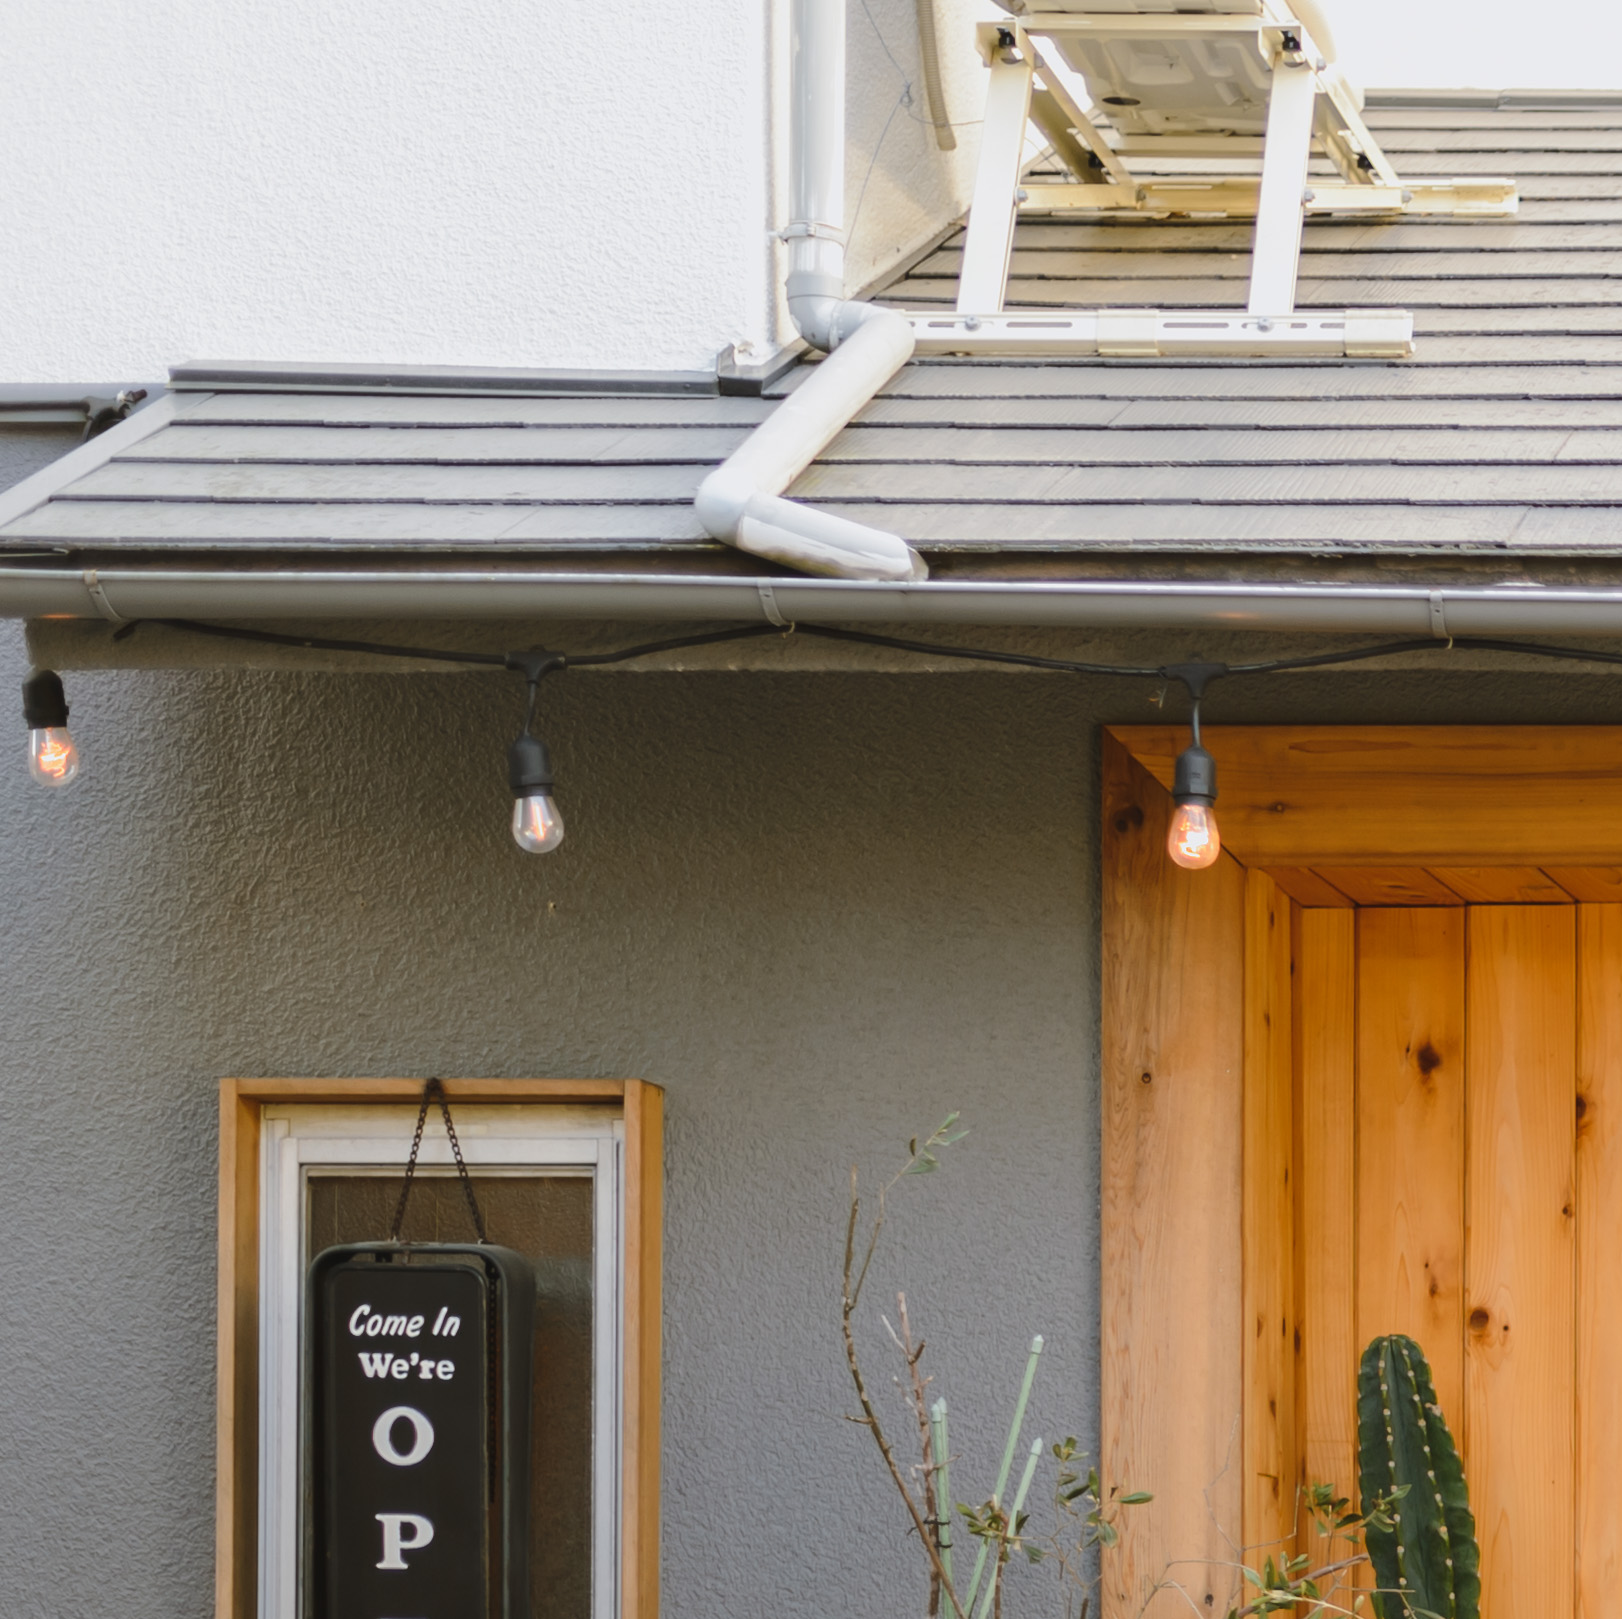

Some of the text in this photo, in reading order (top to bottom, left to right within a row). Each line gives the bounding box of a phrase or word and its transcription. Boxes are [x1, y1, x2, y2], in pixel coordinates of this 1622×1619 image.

[349, 1304, 460, 1338] Come In
[358, 1352, 455, 1381] We're
